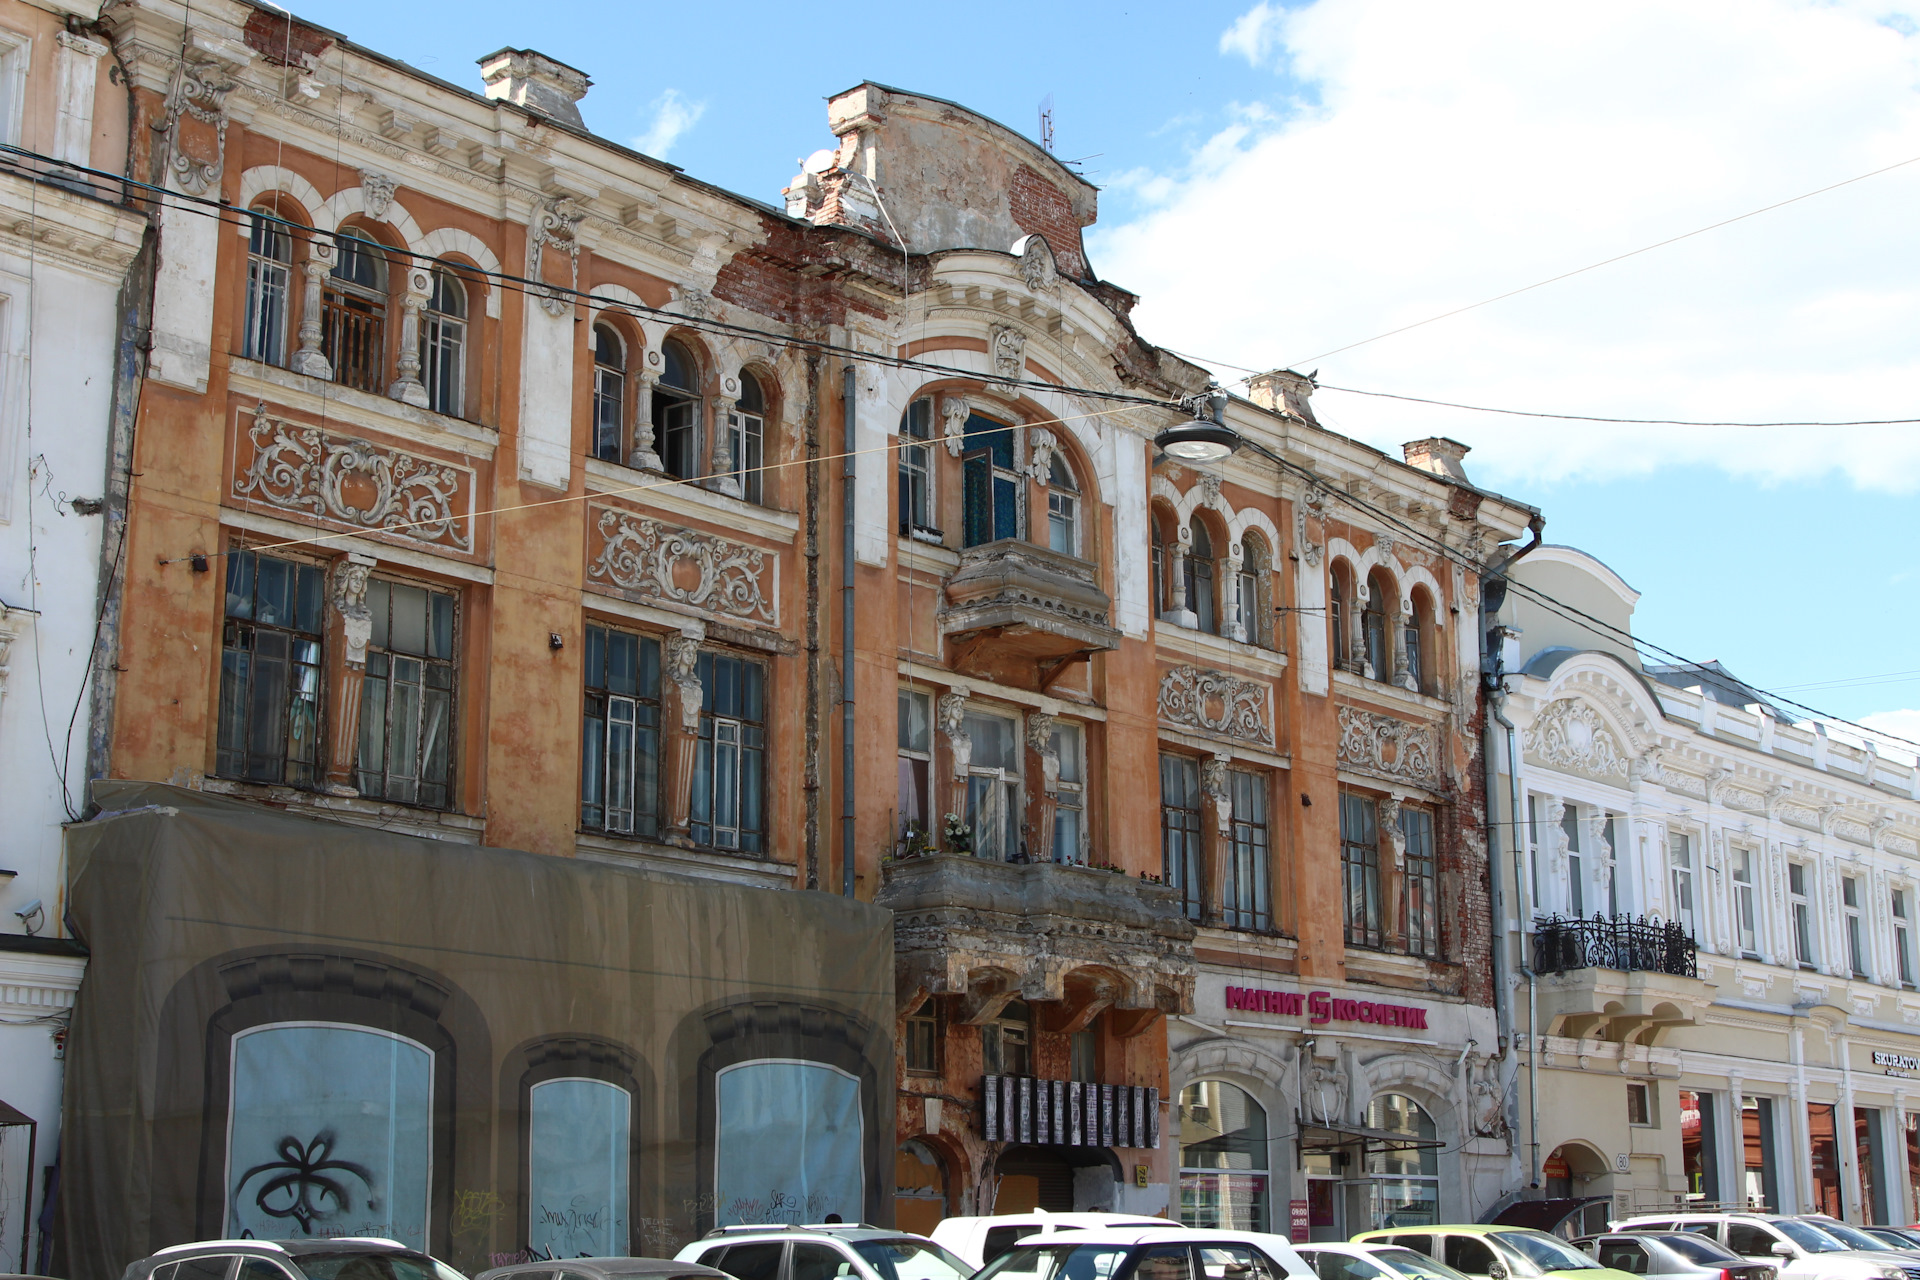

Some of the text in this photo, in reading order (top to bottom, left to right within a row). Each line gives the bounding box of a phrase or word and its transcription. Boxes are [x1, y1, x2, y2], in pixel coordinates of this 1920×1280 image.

[1226, 986, 1428, 1029] МАГНИТ КОСМЕТИК
[1873, 1051, 1919, 1070] SKURATOV
